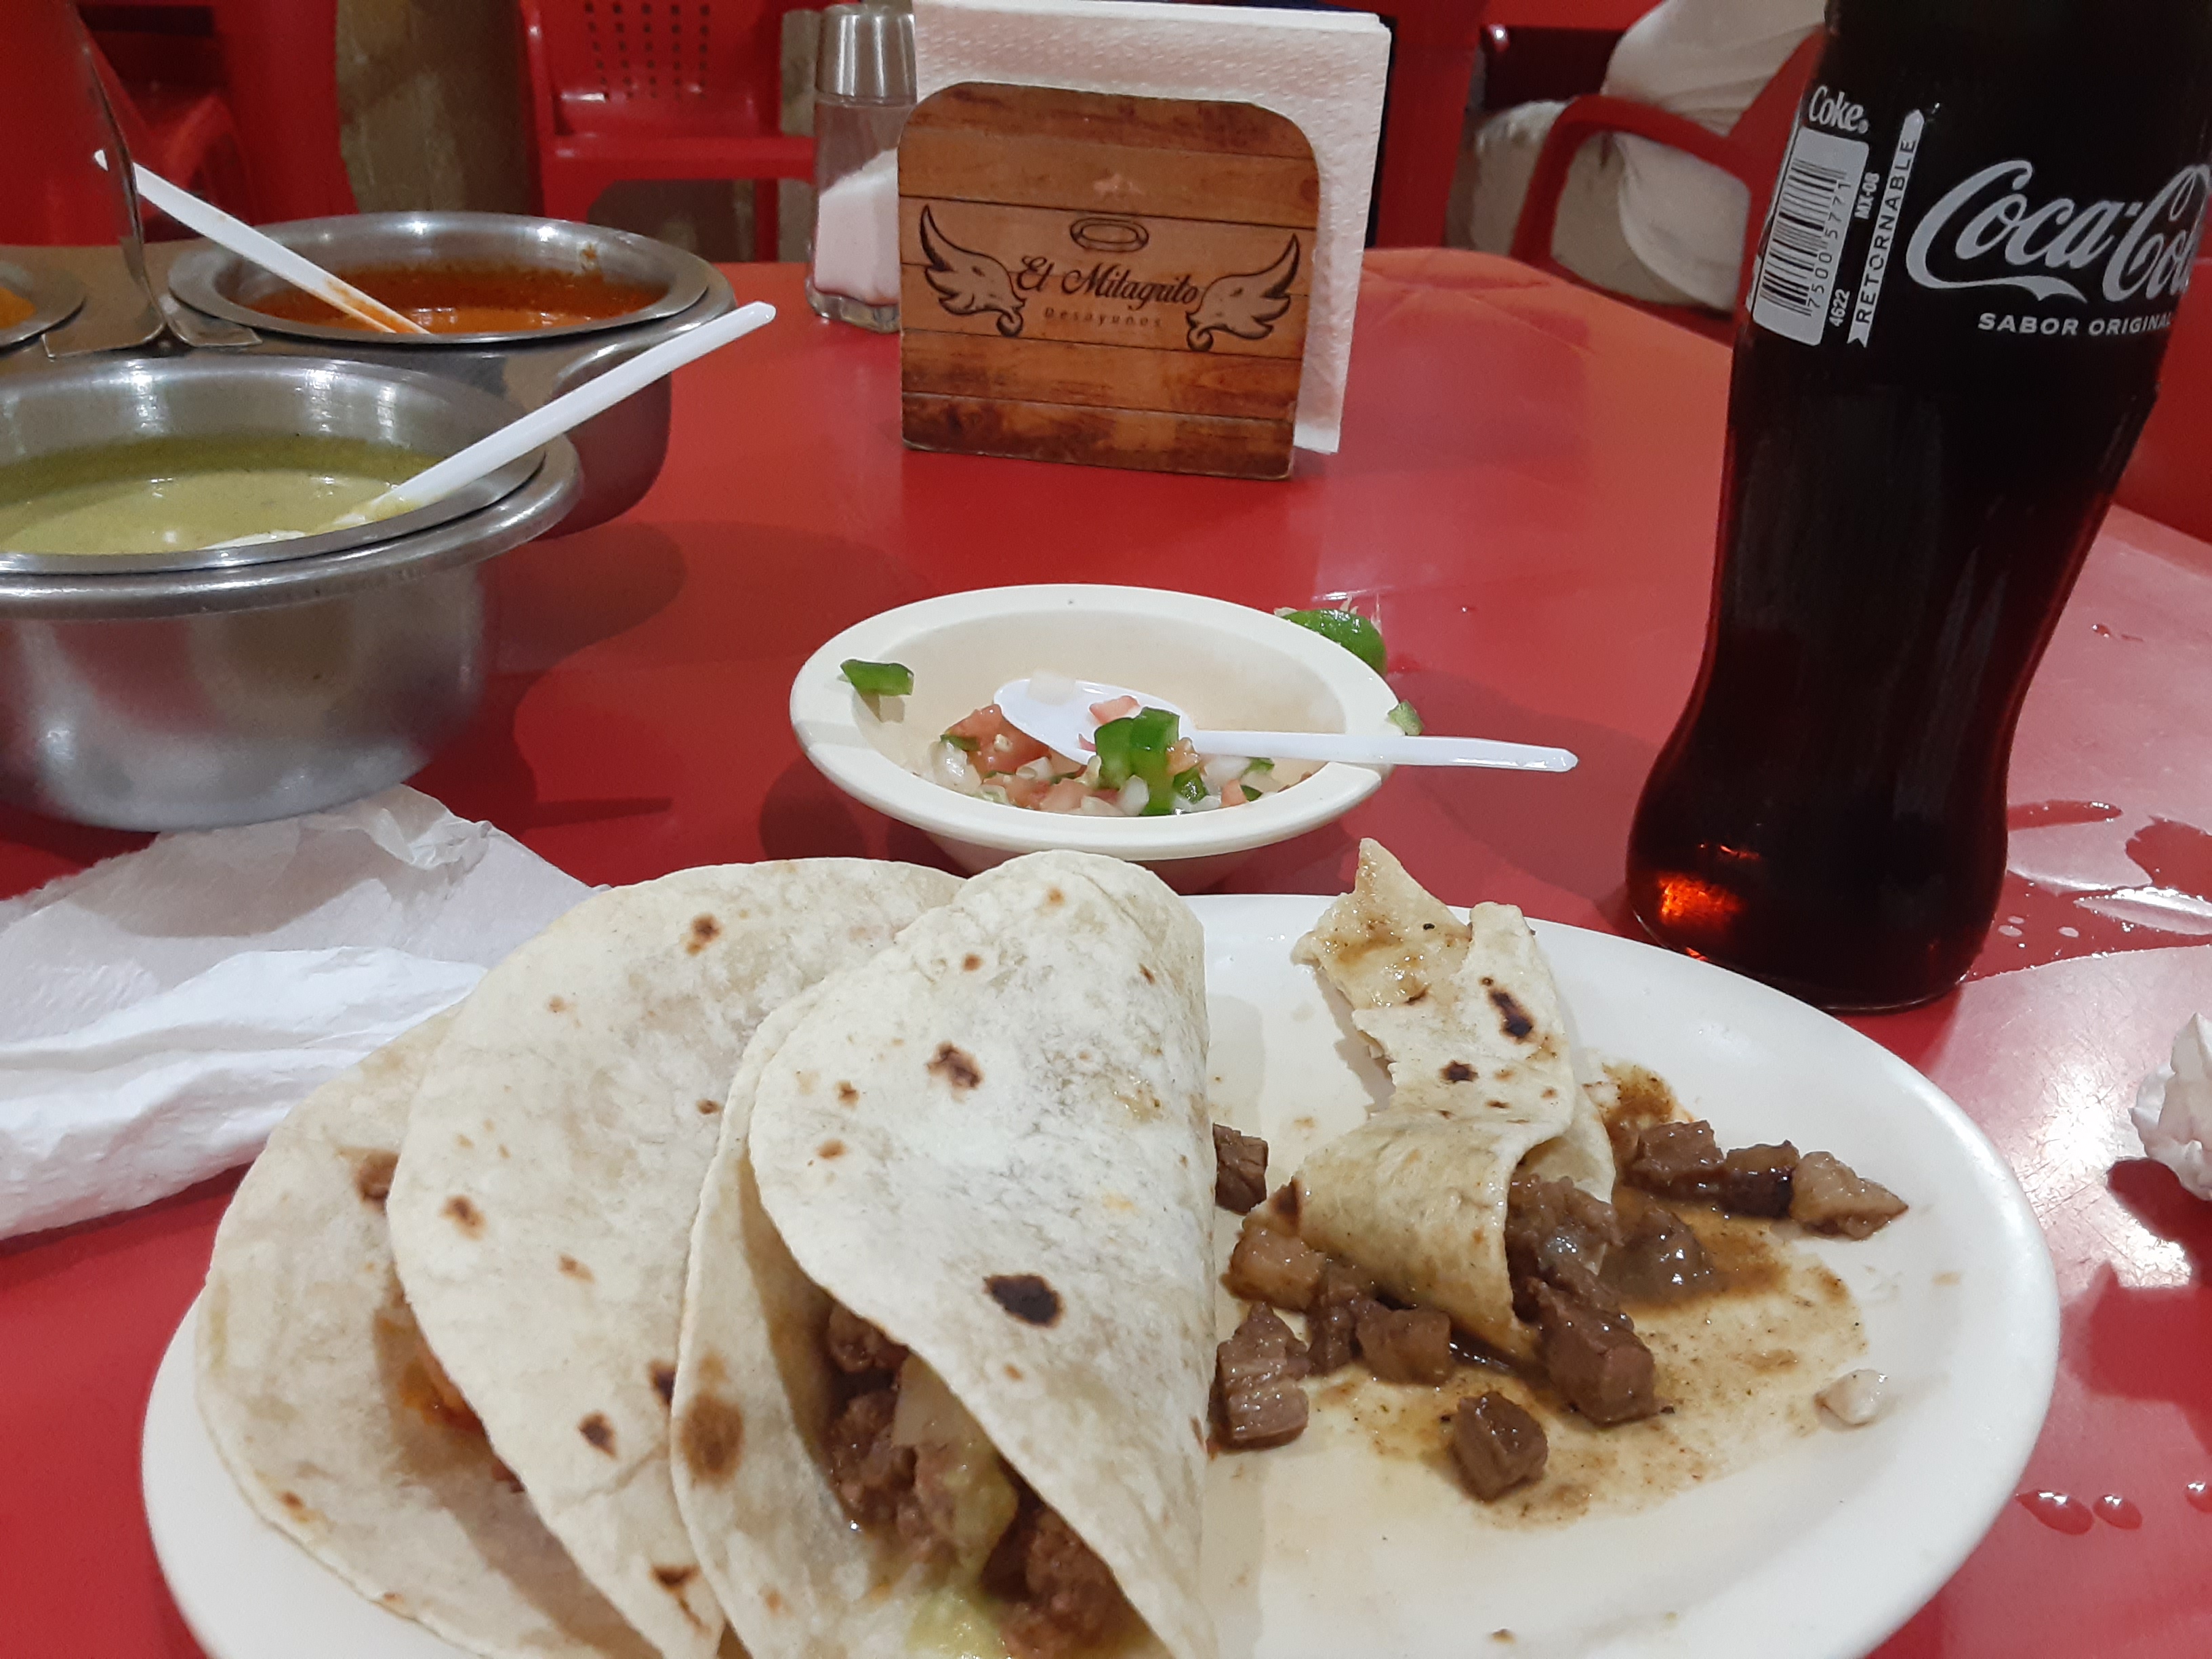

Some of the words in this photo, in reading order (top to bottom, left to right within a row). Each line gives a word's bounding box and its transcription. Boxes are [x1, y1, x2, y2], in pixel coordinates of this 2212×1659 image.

[1829, 288, 1851, 327] 4622
[1853, 171, 1880, 220] MX-08
[1856, 139, 1917, 325] RETORNABLE
[1017, 255, 1055, 291] El
[1061, 262, 1199, 311] Milagrito
[1044, 306, 1163, 328] Desayunos
[1978, 312, 2079, 336] SABOR
